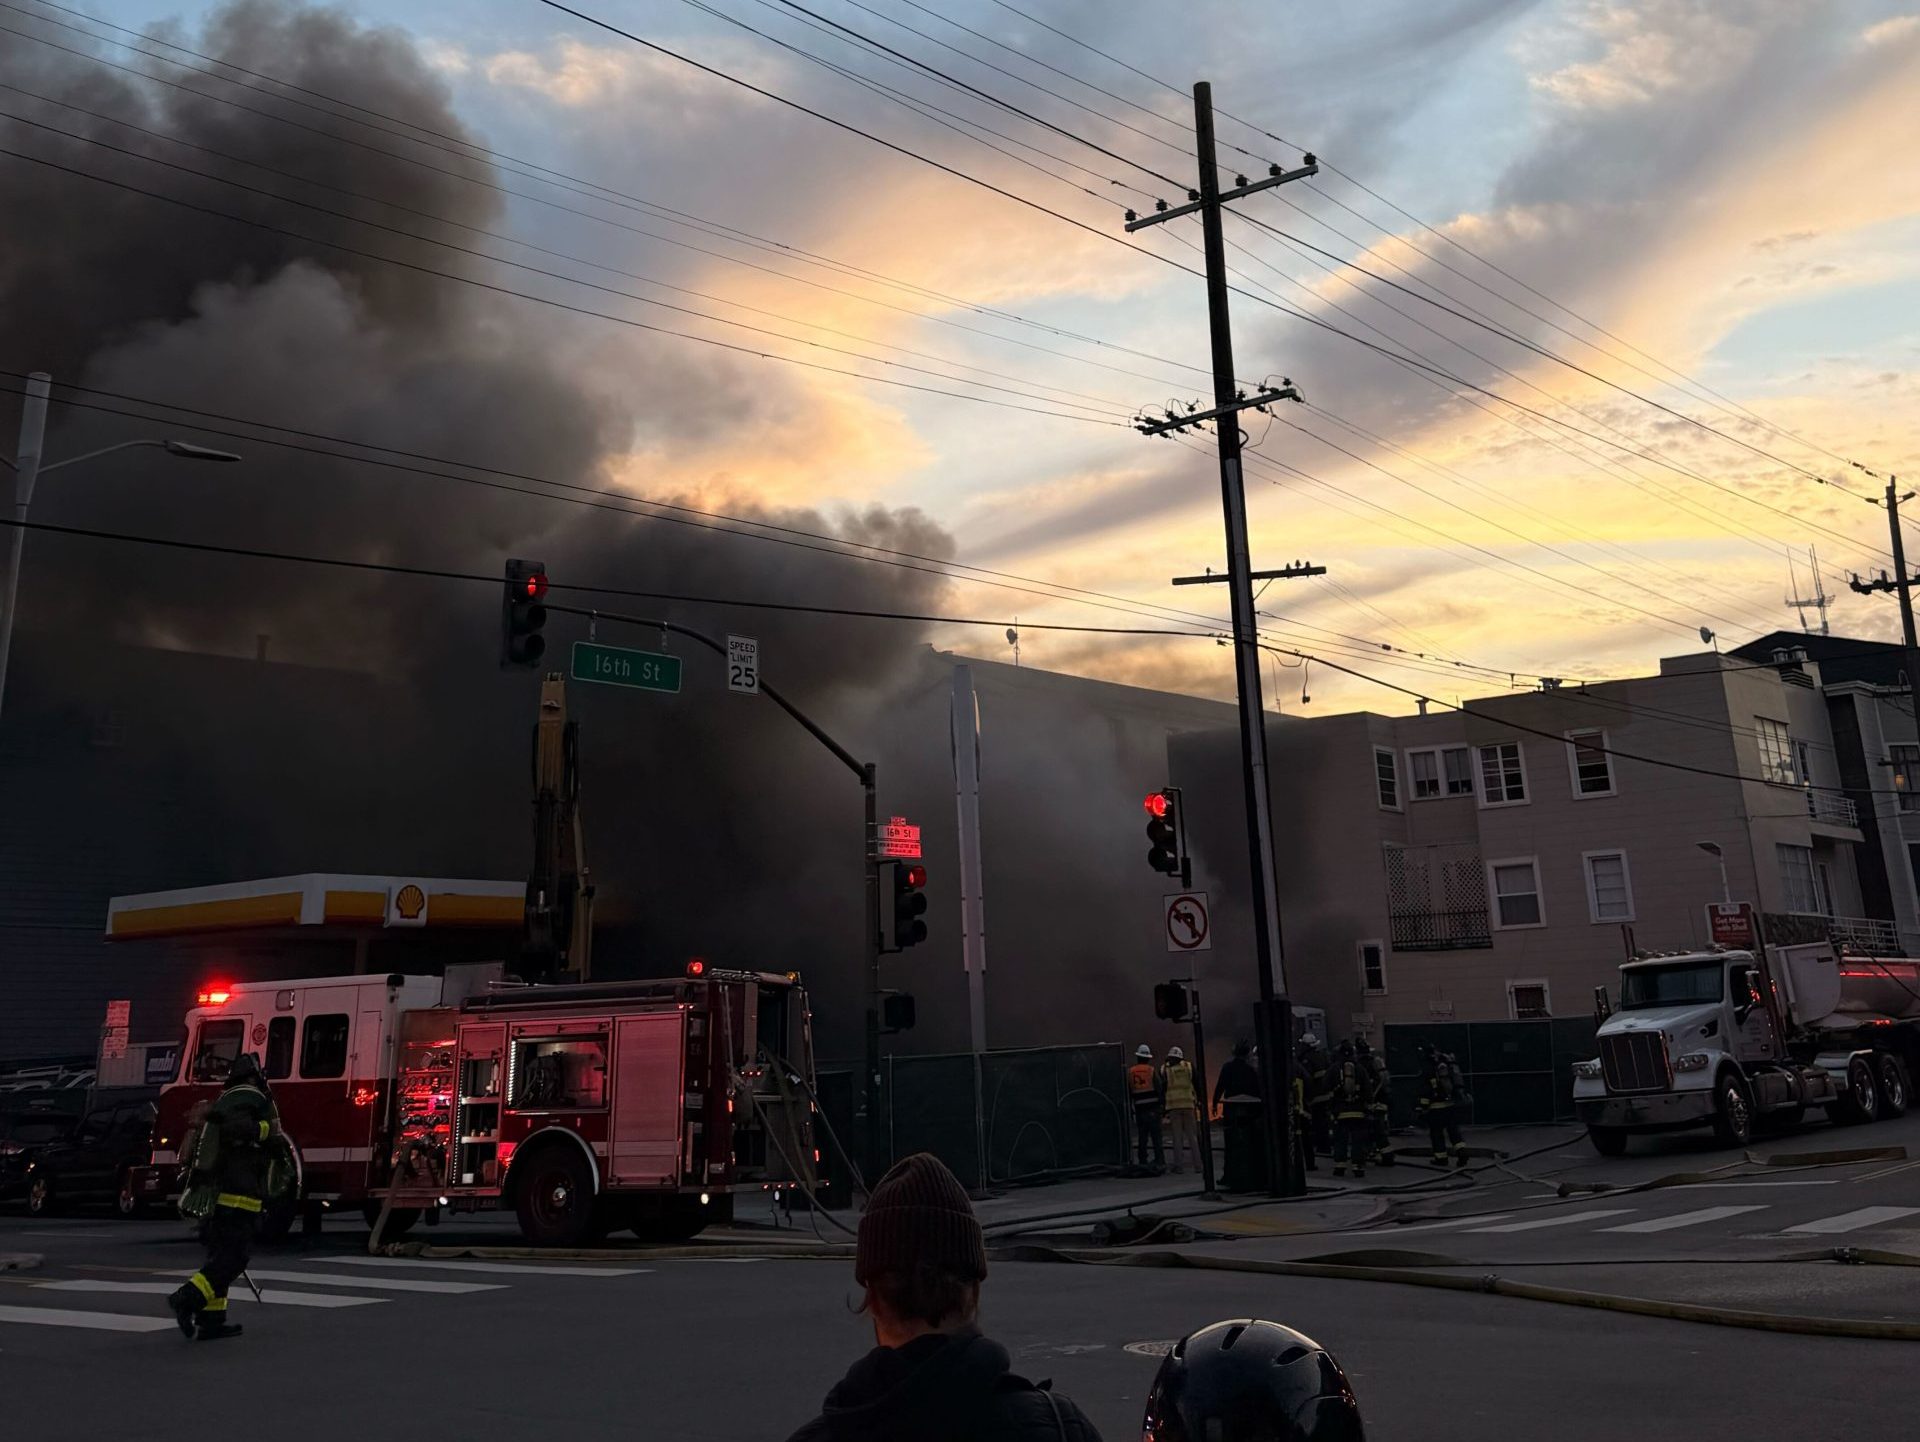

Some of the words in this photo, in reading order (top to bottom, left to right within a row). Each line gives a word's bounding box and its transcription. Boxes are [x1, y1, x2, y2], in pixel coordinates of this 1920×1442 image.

[729, 640, 756, 654] SPEED
[732, 653, 753, 665] LIMIT
[594, 653, 631, 677] 16th
[642, 661, 660, 681] St
[731, 665, 755, 688] 25
[887, 827, 900, 837] 16th
[903, 829, 911, 838] St
